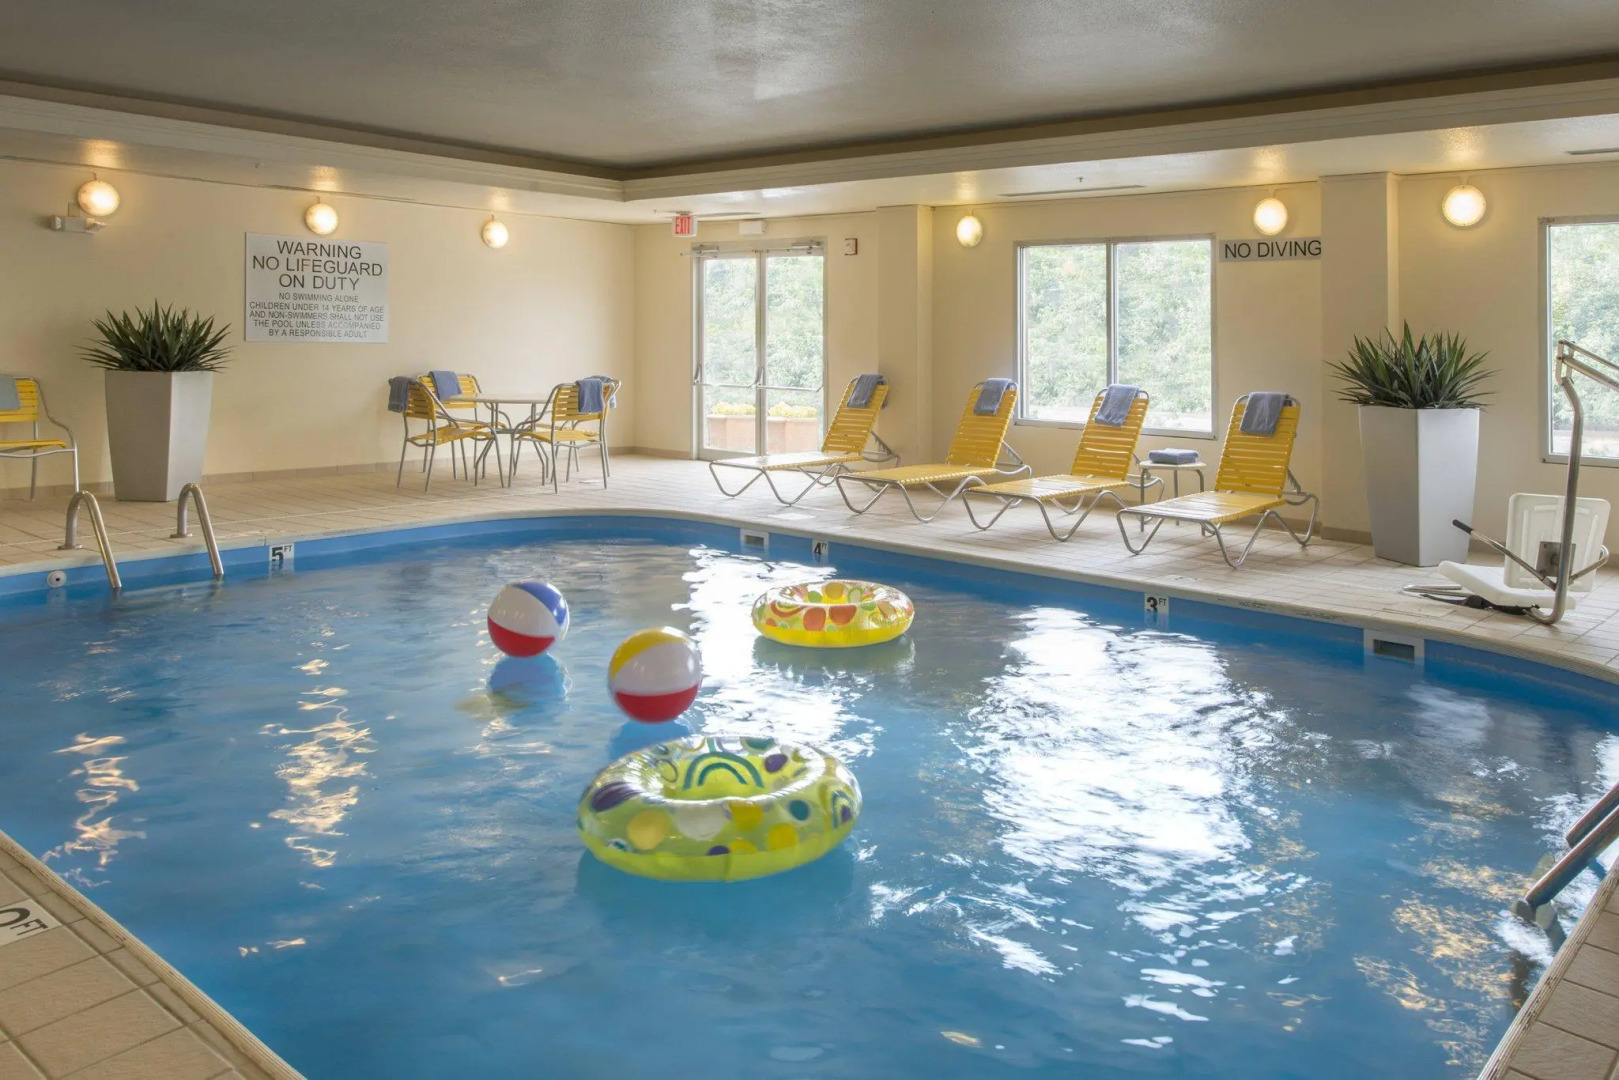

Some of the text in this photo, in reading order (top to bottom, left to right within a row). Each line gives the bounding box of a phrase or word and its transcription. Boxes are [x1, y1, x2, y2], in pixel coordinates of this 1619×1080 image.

[675, 215, 690, 235] EXIT
[277, 240, 362, 260] WARNING
[1224, 239, 1322, 259] NO DIVING
[252, 255, 383, 277] NO LIFEGUARD
[279, 273, 360, 291] ON DUTY
[279, 292, 359, 303] NO SWIMMING ALONE
[249, 301, 290, 310] CHILDREN
[292, 303, 319, 311] UNDER
[332, 304, 356, 312] YEARS
[369, 305, 385, 314] AGE
[249, 310, 385, 322] AND NON-SWIMMERS SHALL NOT USE
[253, 319, 381, 330] THE POOL UNLESS ACCOMPANIED
[268, 328, 368, 338] BY A RESPONSIBLE ADULT
